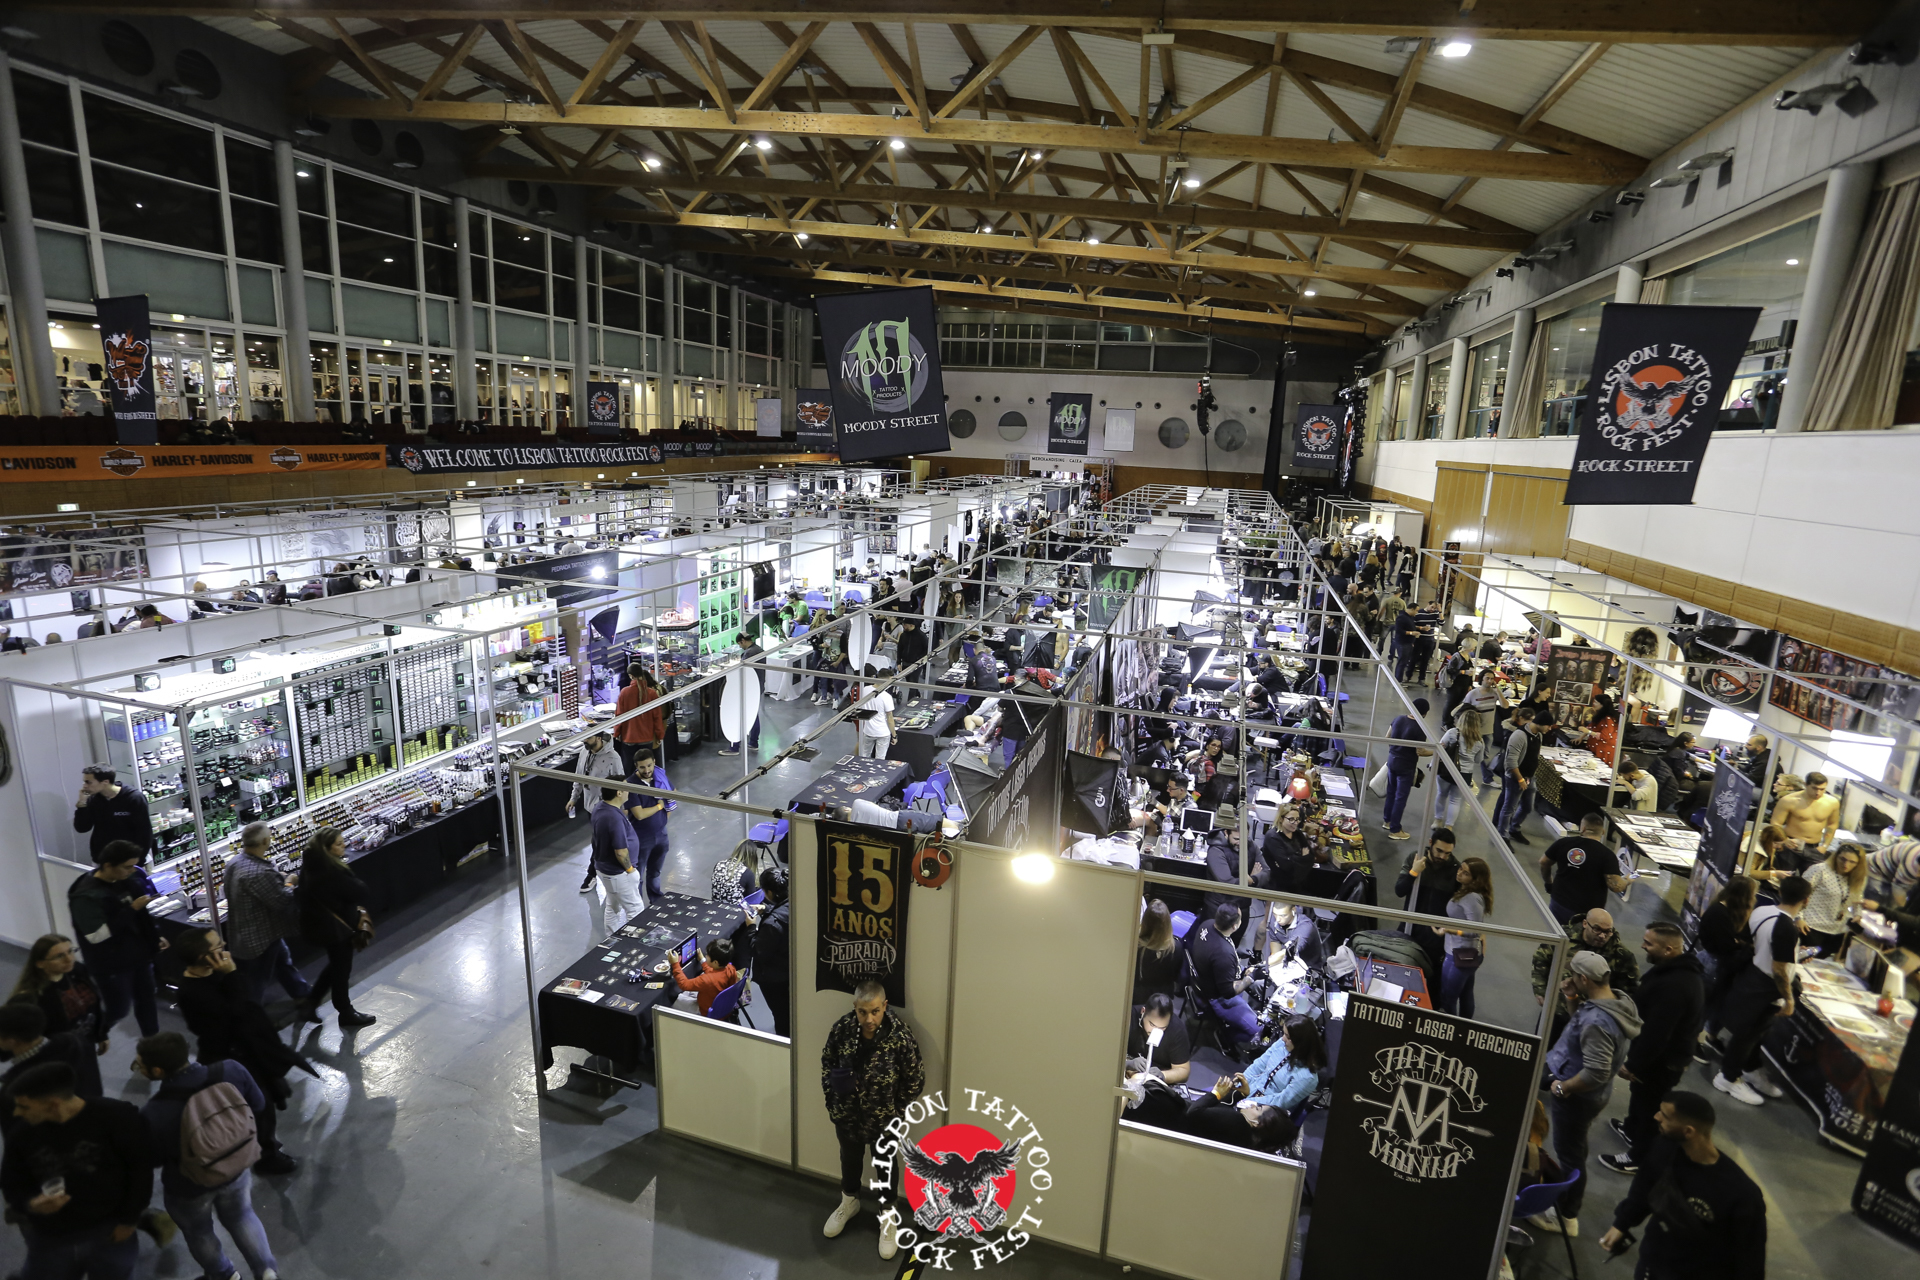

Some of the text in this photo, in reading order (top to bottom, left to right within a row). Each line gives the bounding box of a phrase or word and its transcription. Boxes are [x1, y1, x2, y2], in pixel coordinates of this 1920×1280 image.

[840, 352, 927, 379] MOODY
[1597, 343, 1712, 407] LISBON TATTOO
[876, 391, 902, 399] PRODUCTS
[843, 420, 887, 434] MOODY
[890, 414, 940, 429] STREET
[1053, 415, 1086, 425] MOODY
[1321, 415, 1337, 438] TATTOO
[1596, 411, 1694, 452] ROCK FEST
[422, 449, 496, 468] WELCOME
[494, 448, 514, 466] TO
[514, 447, 559, 465] LISBON
[556, 446, 600, 463] TATTOO
[600, 447, 626, 464] ROCK
[625, 445, 649, 461] FEST
[663, 443, 683, 451] MOODY
[1, 457, 77, 470] DAVIDSON
[152, 454, 254, 467] HARLEY-DAVIDSON
[306, 452, 381, 463] HARLEY-DAVIDSON
[1577, 459, 1694, 473] ROCK STREET
[551, 564, 571, 573] PEDRADA
[571, 561, 588, 569] TATTOO
[1091, 587, 1133, 600] MOOD
[830, 840, 894, 913] 15
[832, 908, 893, 940] ANOS
[826, 940, 896, 973] PEDRADA
[1353, 1001, 1532, 1061] TATTOOS LASER PIERCINGS
[1369, 1130, 1467, 1179] MANIA
[1406, 1175, 1421, 1183] 2004
